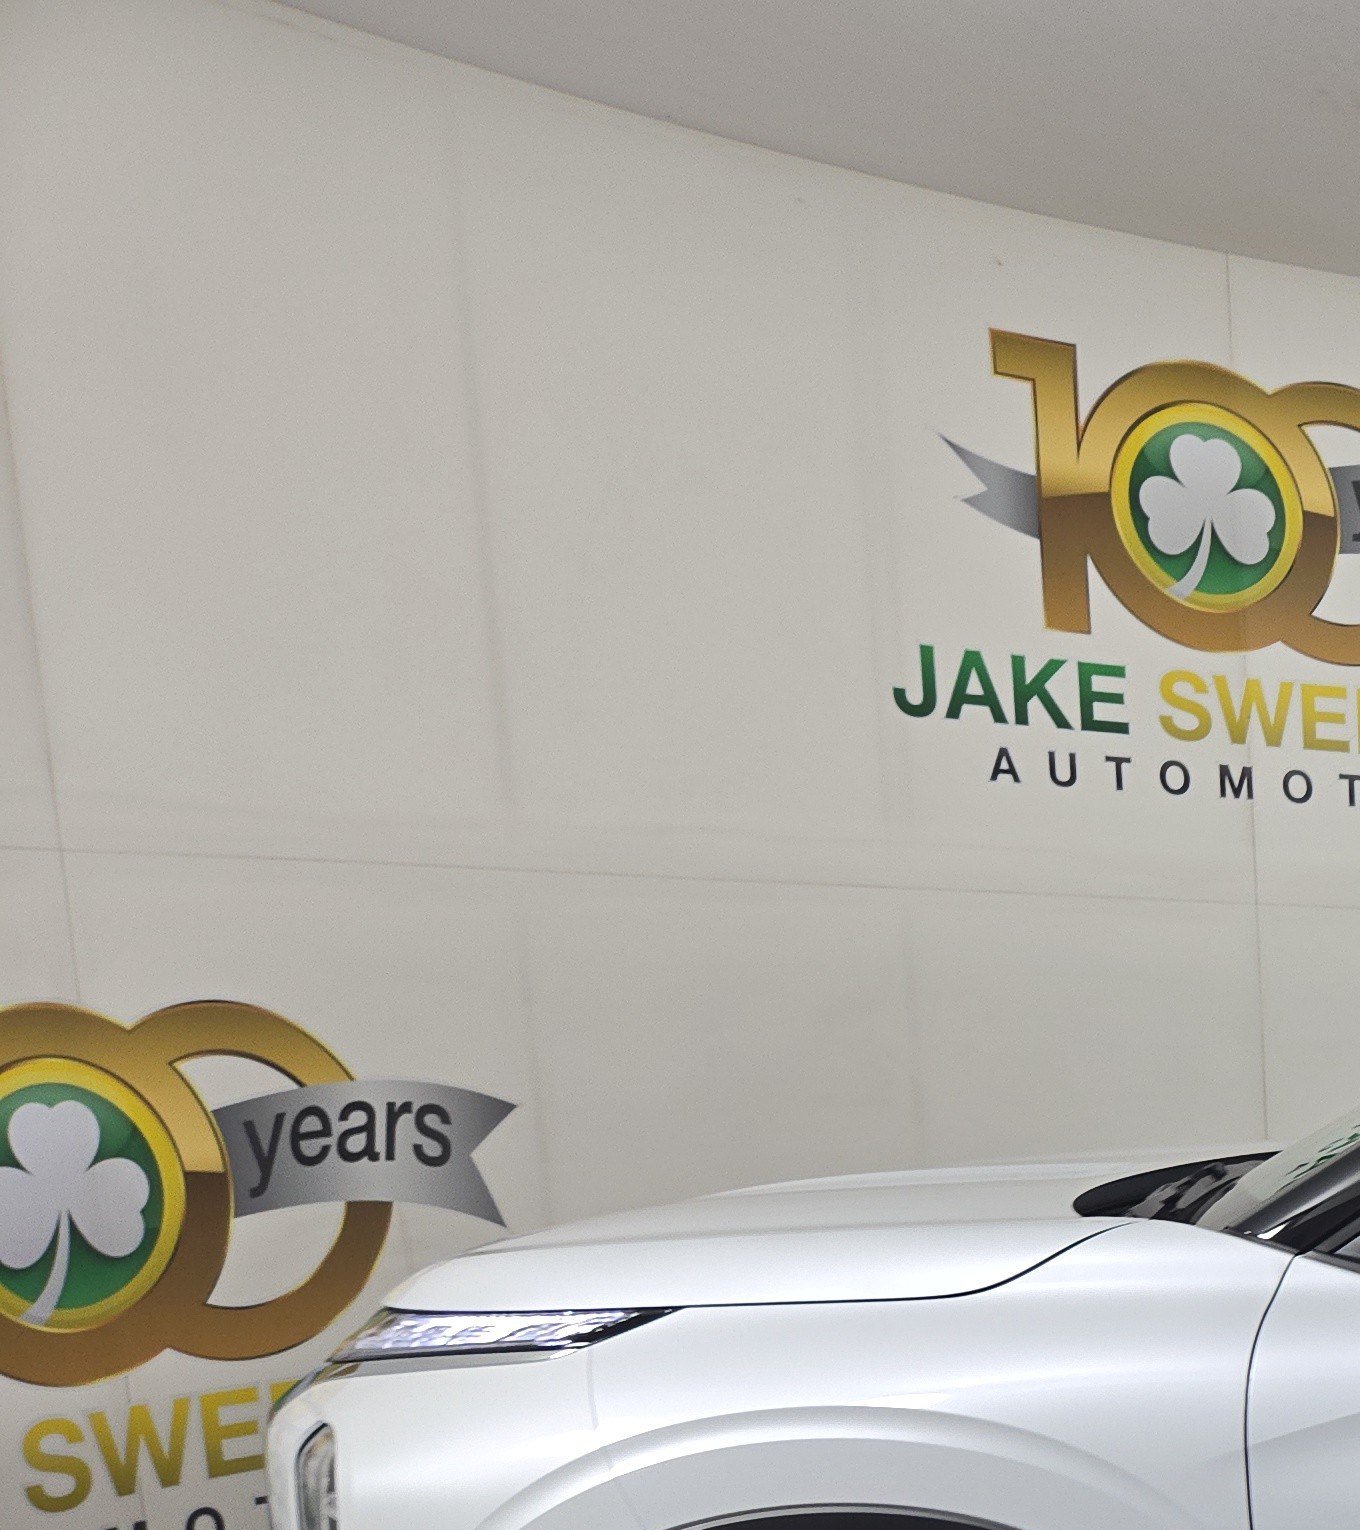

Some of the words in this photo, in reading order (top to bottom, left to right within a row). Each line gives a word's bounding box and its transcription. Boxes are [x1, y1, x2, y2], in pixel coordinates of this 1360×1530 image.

[892, 643, 1131, 736] JAKE
[242, 1100, 453, 1199] years
[21, 1379, 303, 1514] SWE
